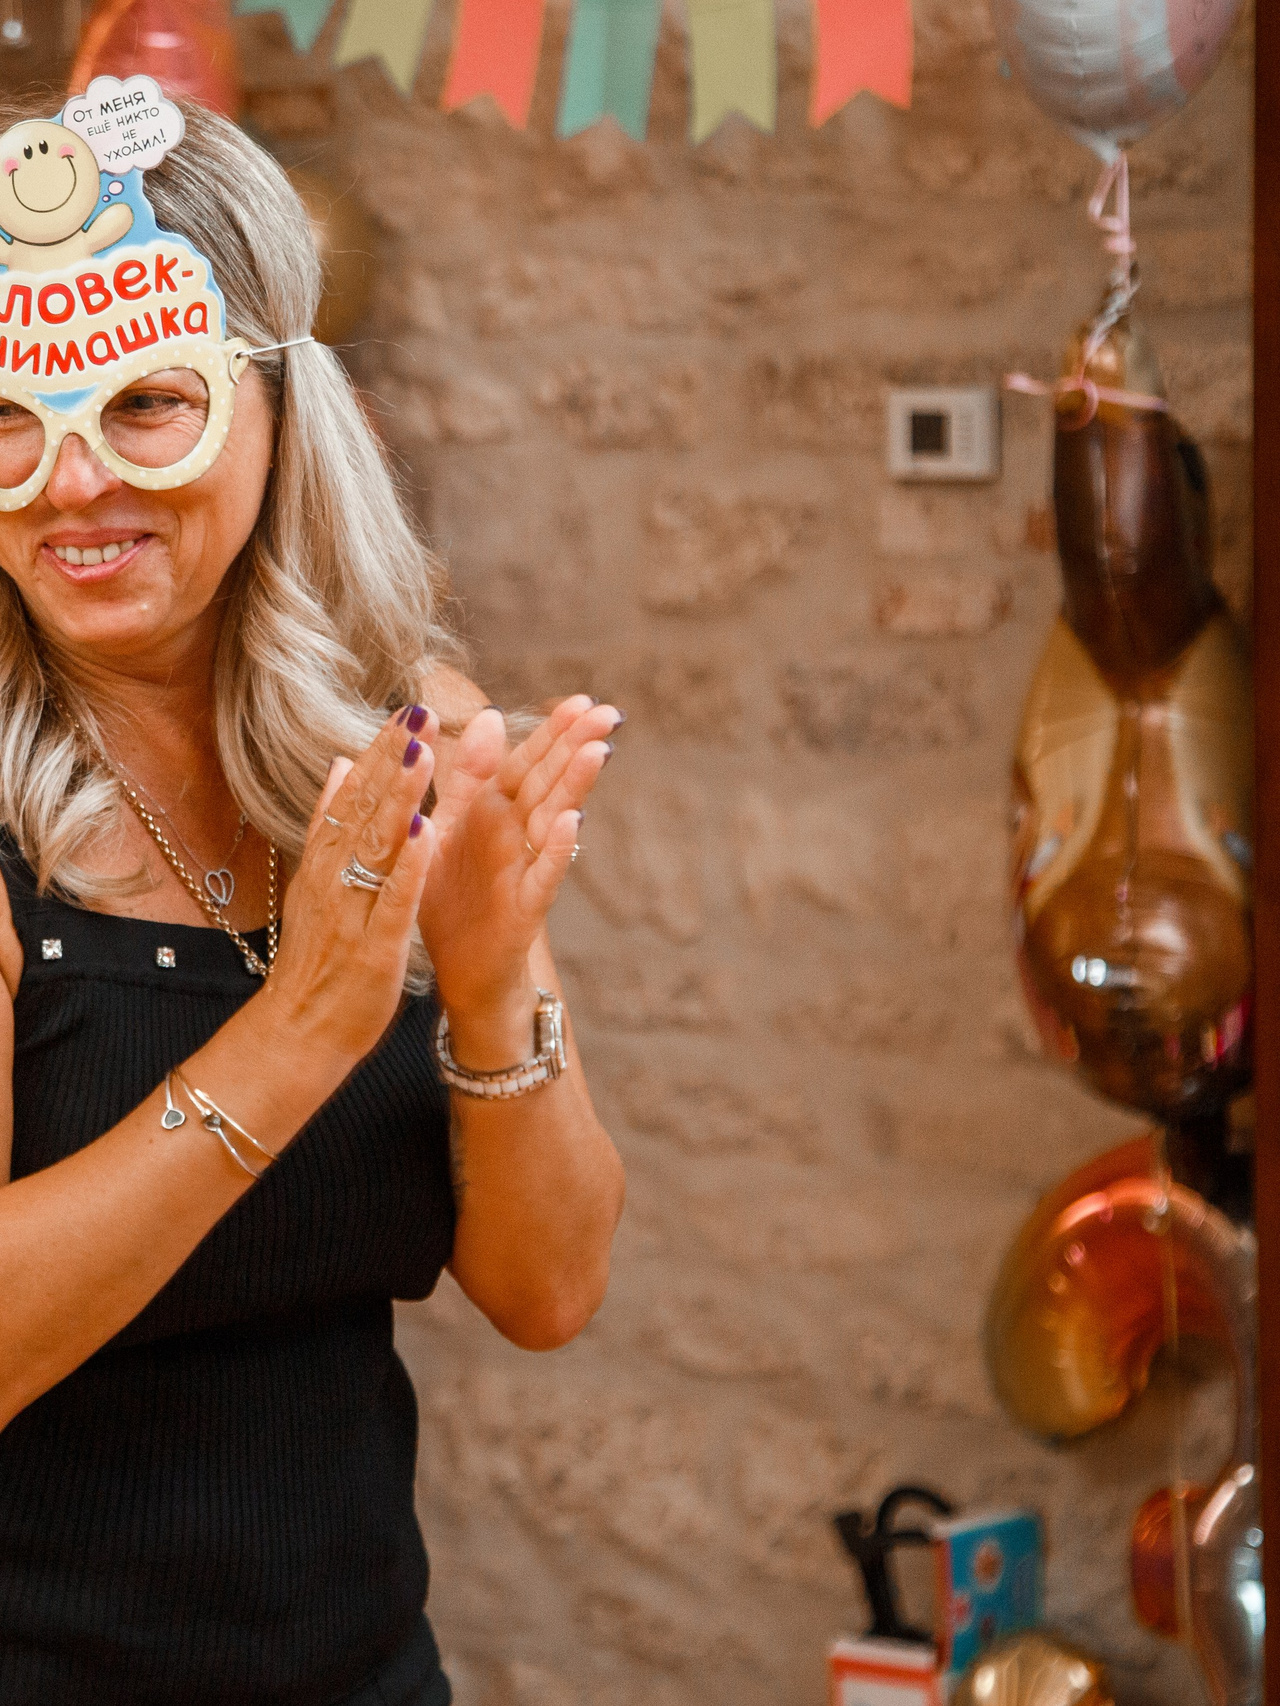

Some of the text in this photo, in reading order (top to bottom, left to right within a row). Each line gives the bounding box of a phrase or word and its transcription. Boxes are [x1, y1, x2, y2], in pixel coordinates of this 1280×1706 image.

[100, 91, 146, 116] МЕНЯ
[87, 107, 160, 136] ЕЩЁ НИКТО
[122, 129, 137, 141] НЕ
[104, 128, 166, 162] УХОДИЛ!
